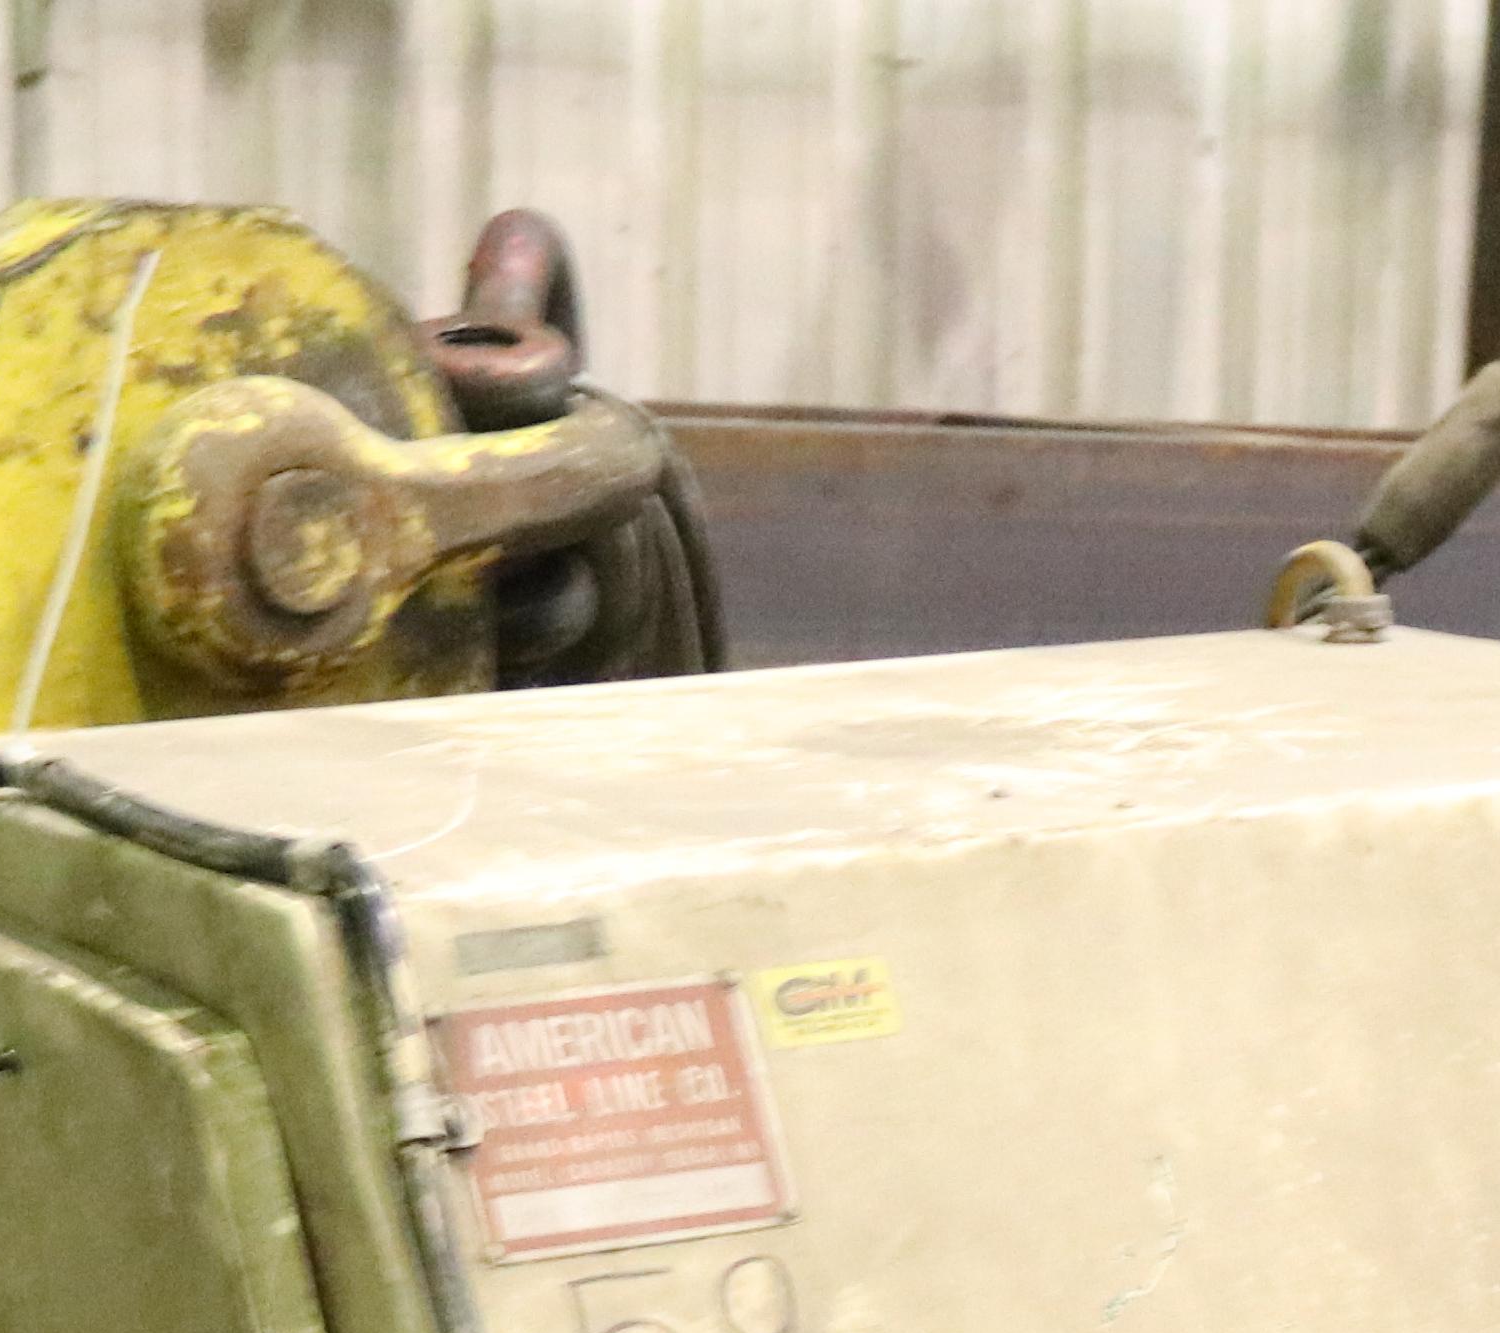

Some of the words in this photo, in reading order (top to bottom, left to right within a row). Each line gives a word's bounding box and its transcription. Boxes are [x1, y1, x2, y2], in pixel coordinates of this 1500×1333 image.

[468, 1000, 716, 1079] AMERICAN
[472, 1081, 578, 1129] STEEL
[584, 1070, 671, 1117] LINE
